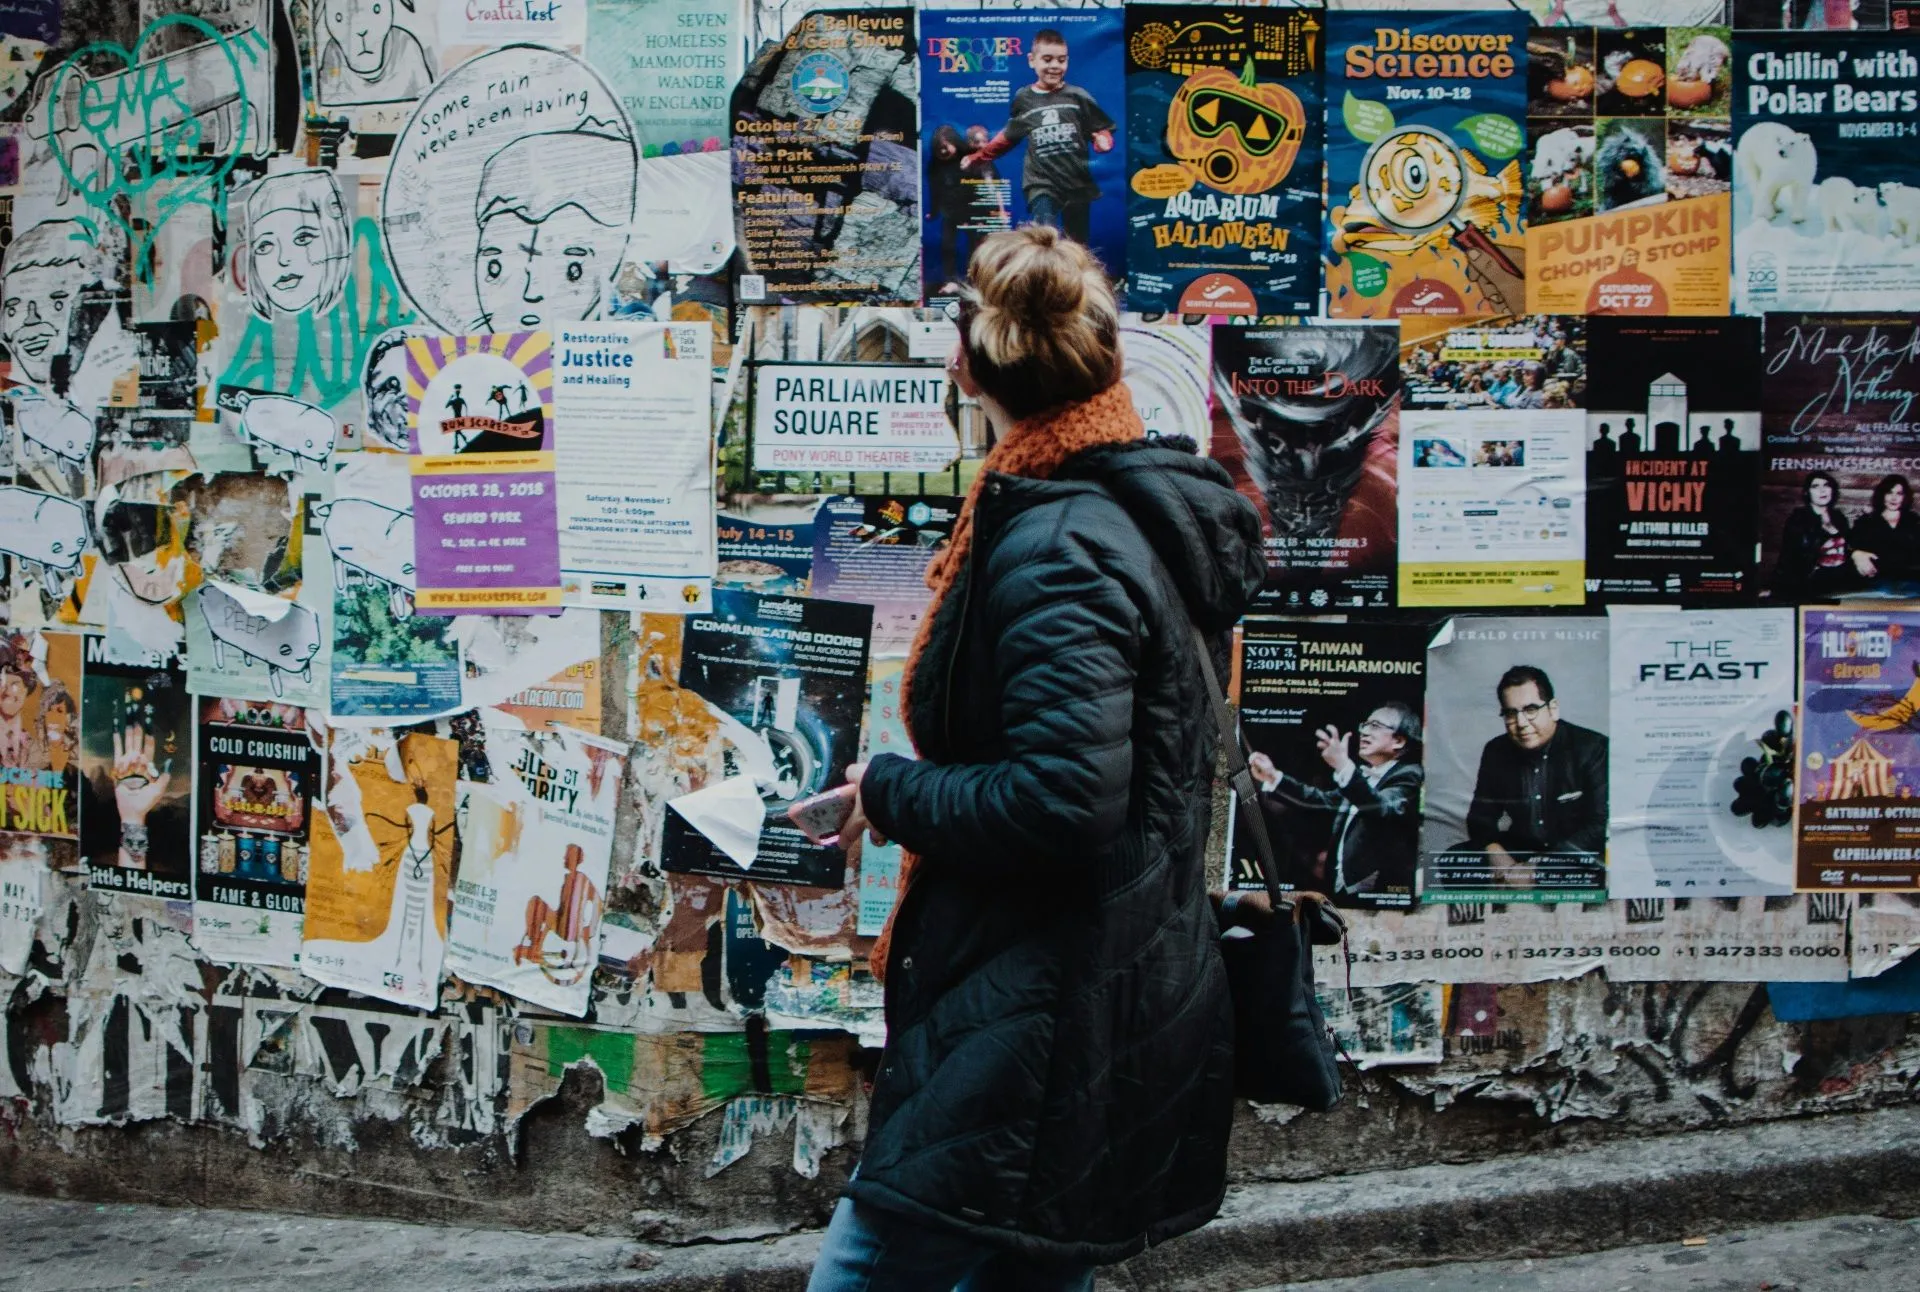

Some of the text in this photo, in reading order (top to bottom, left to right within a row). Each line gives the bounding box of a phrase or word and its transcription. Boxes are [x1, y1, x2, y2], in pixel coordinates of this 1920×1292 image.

[678, 13, 726, 27] SEVEN
[824, 14, 904, 30] Bellevue
[646, 35, 726, 47] HOMELESS
[786, 34, 904, 49] & Gem Show
[927, 37, 1023, 56] DISCOVER
[1375, 28, 1514, 52] Discover
[629, 55, 725, 68] MAMMOTHS
[939, 55, 1009, 73] DANCE
[1345, 45, 1515, 78] Science
[1748, 49, 1918, 81] Chillin' with
[658, 76, 725, 89] WANDER
[1386, 86, 1423, 100] Nov.
[1749, 84, 1917, 115] Polar Bears
[421, 74, 530, 135] Some rain
[620, 96, 725, 110] EW ENGLAND
[468, 105, 512, 137] been
[735, 120, 798, 132] October
[803, 119, 822, 131] 27
[1839, 122, 1917, 138] NOVEMBER 3-4
[738, 148, 814, 162] Vasa Park
[738, 192, 814, 205] Featuring
[1163, 191, 1280, 222] AQUARIUM
[1152, 220, 1290, 251] HALLOWEEN
[1538, 201, 1720, 261] PUMPKIN
[1538, 254, 1615, 283] CHOMP
[1646, 236, 1721, 262] STOMP
[1748, 271, 1778, 283] ZOO
[1599, 284, 1653, 294] SATURDAY
[1599, 295, 1653, 308] OCT 27
[563, 332, 629, 344] Restorative
[562, 348, 634, 367] Justice
[563, 374, 631, 388] and Healing
[775, 377, 943, 404] PARLIAMENT
[441, 417, 509, 433] RUN SCARED
[774, 409, 880, 436] SQUARE
[1855, 423, 1910, 432] ALL FEMALE
[773, 450, 806, 461] PONY
[809, 450, 853, 463] WORLD
[857, 451, 910, 463] THEATRE
[1625, 460, 1709, 476] INCIDENT AT
[419, 482, 545, 499] OCTOBER 28, 2018
[1626, 482, 1706, 512] VICHY
[490, 511, 522, 523] PARK
[1629, 522, 1669, 535] ARTHUR
[1672, 522, 1709, 535] MILLER
[1306, 538, 1368, 548] NOVEMBER 3
[1585, 579, 1601, 592] W
[758, 599, 804, 613] Lamplight
[692, 619, 864, 648] COMMUNICATING DOORS
[1513, 631, 1601, 641] CITY MUSIC
[794, 643, 816, 653] ALAN
[1247, 646, 1281, 657] NOV
[1300, 641, 1363, 656] TAIWAN
[1666, 640, 1732, 658] THE
[1245, 659, 1296, 671] 7:30PM
[1300, 658, 1422, 675] PHILHARMONIC
[1640, 662, 1769, 682] FEAST
[1252, 686, 1288, 694] STEPHEN
[210, 737, 312, 762] COLD CRUSHIN'
[13, 786, 69, 835] SICK
[89, 867, 189, 897] ittle Helpers
[5, 882, 25, 900] MAY
[212, 886, 247, 905] FAME
[252, 891, 260, 907] &
[1431, 947, 1484, 959] 6000
[1609, 946, 1660, 957] 6000
[1789, 946, 1840, 958] 6000
